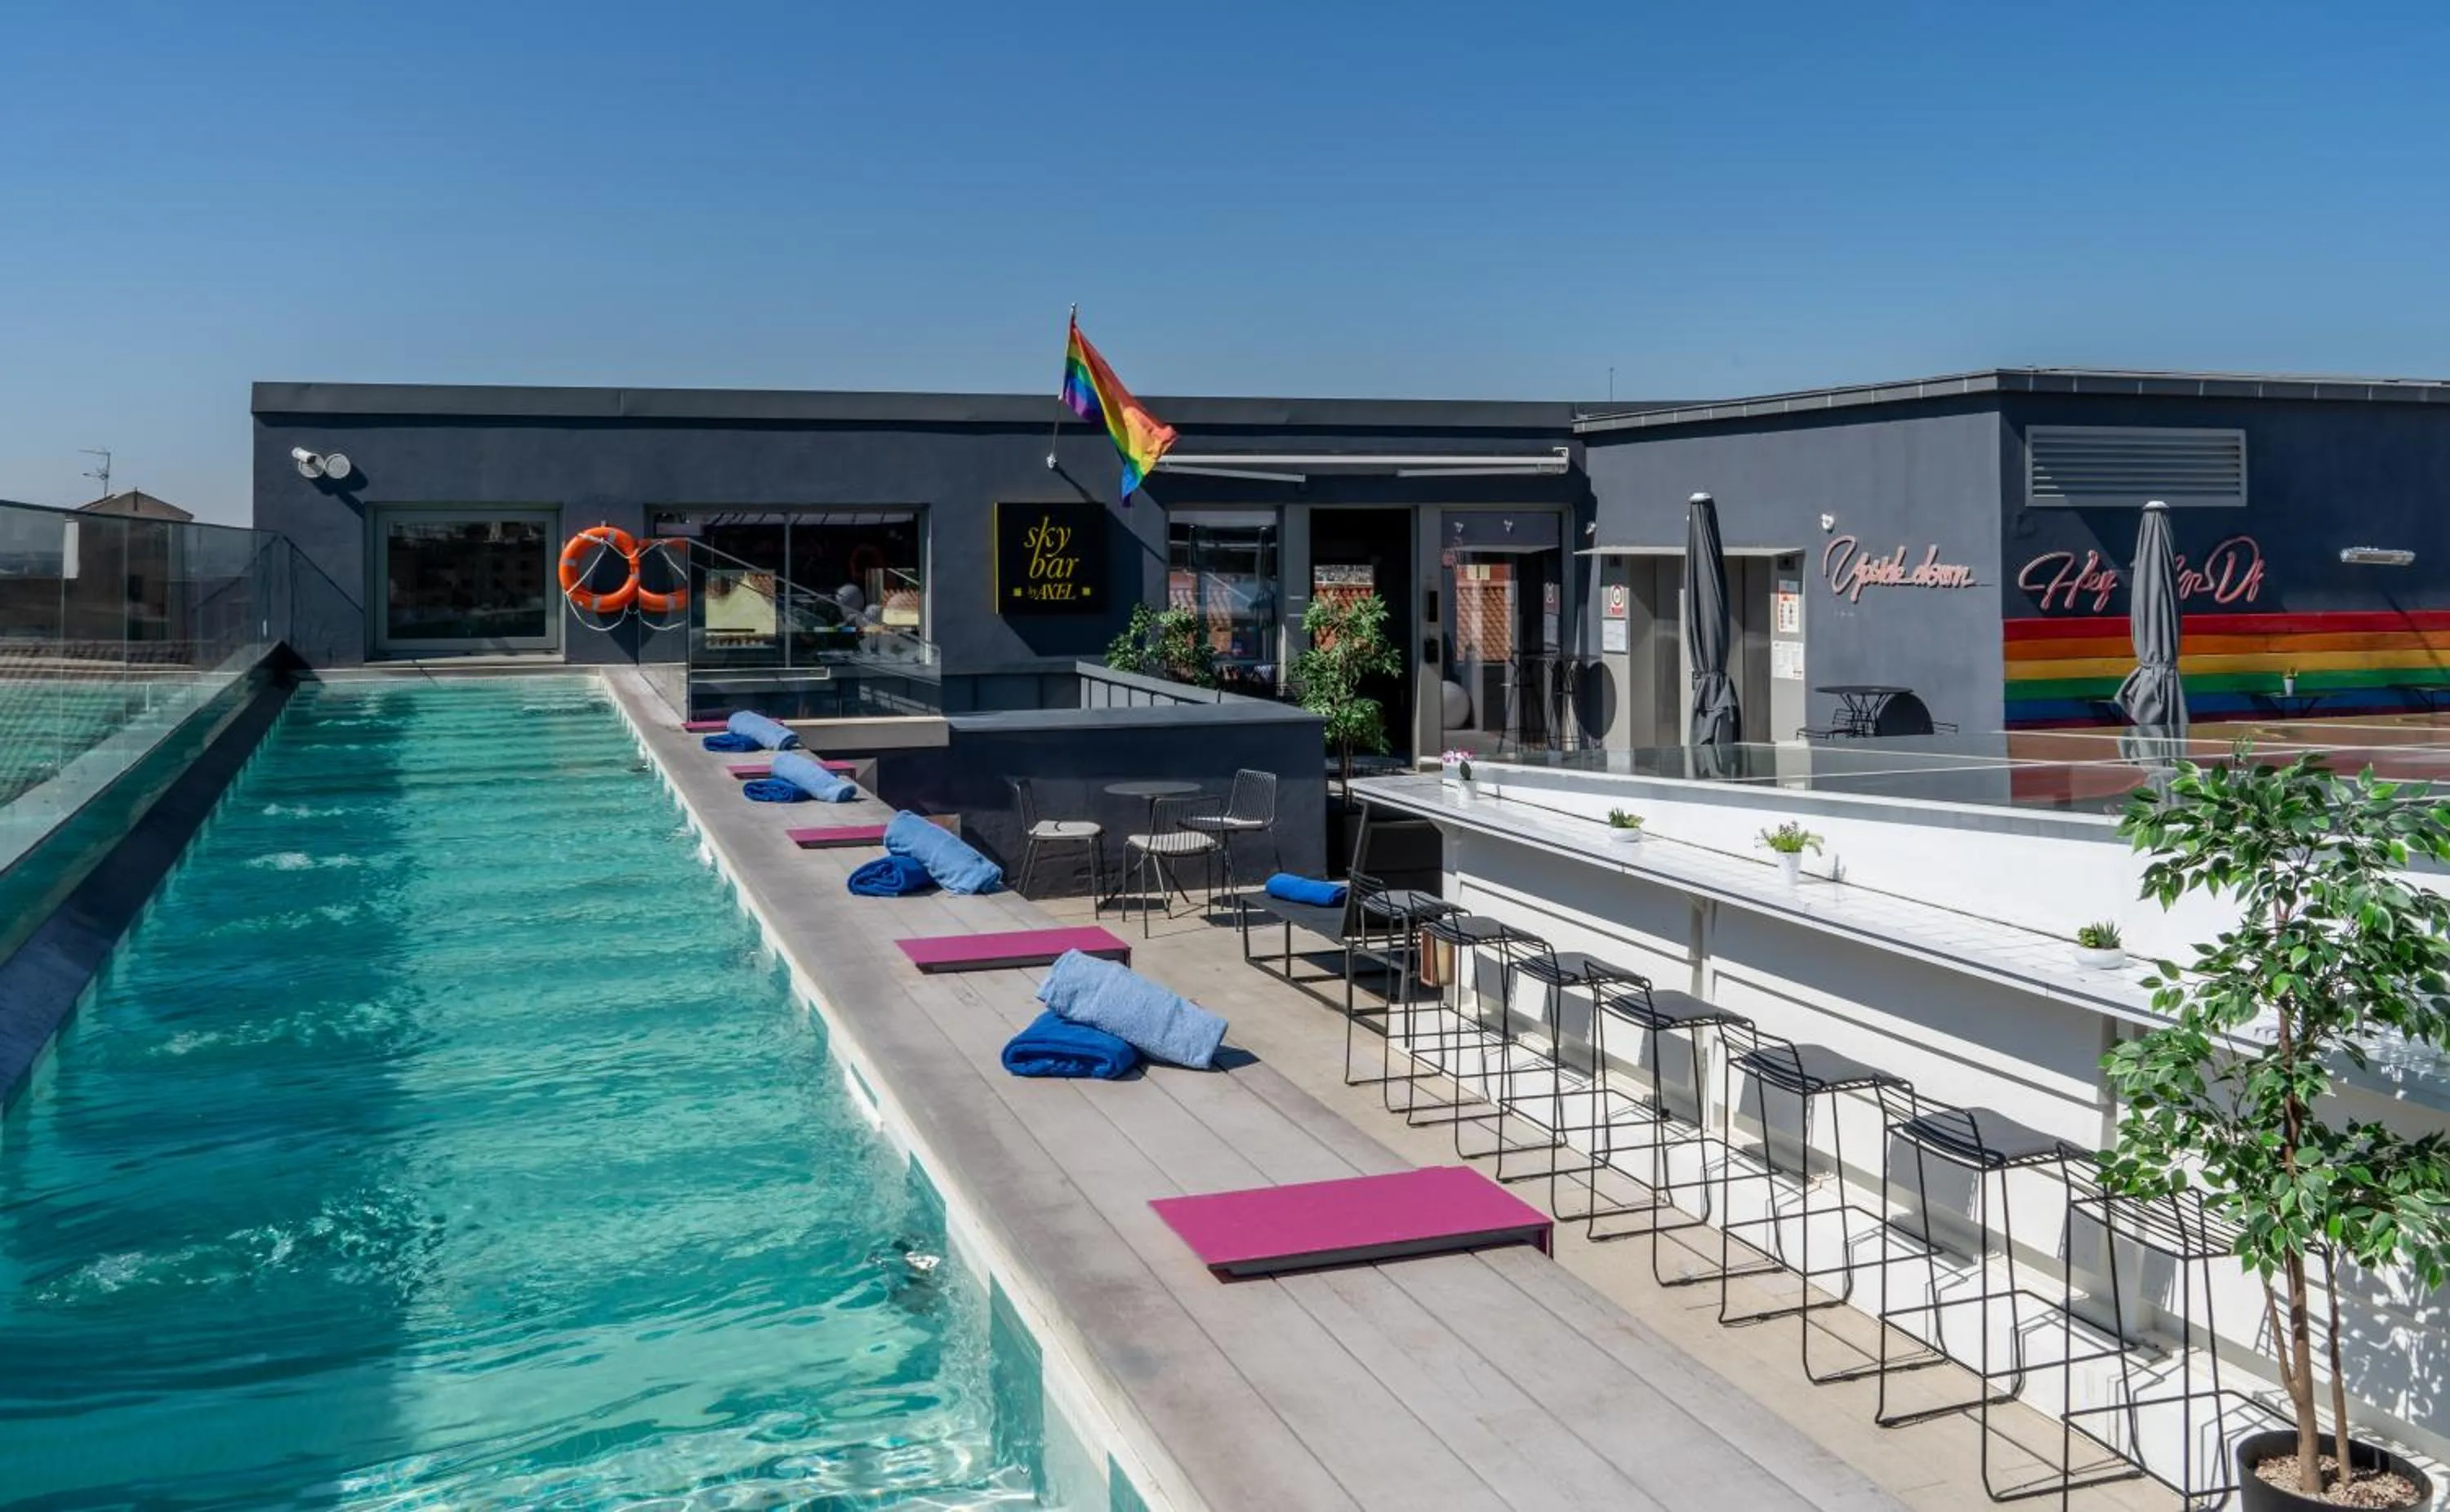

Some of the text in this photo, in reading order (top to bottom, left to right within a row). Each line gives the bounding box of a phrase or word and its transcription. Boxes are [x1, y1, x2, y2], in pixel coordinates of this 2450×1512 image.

[1023, 516, 1071, 557] sky
[1029, 557, 1080, 579] bar
[1912, 544, 1975, 588] down
[2018, 549, 2118, 612] Hey
[1038, 583, 1076, 600] AXEL
